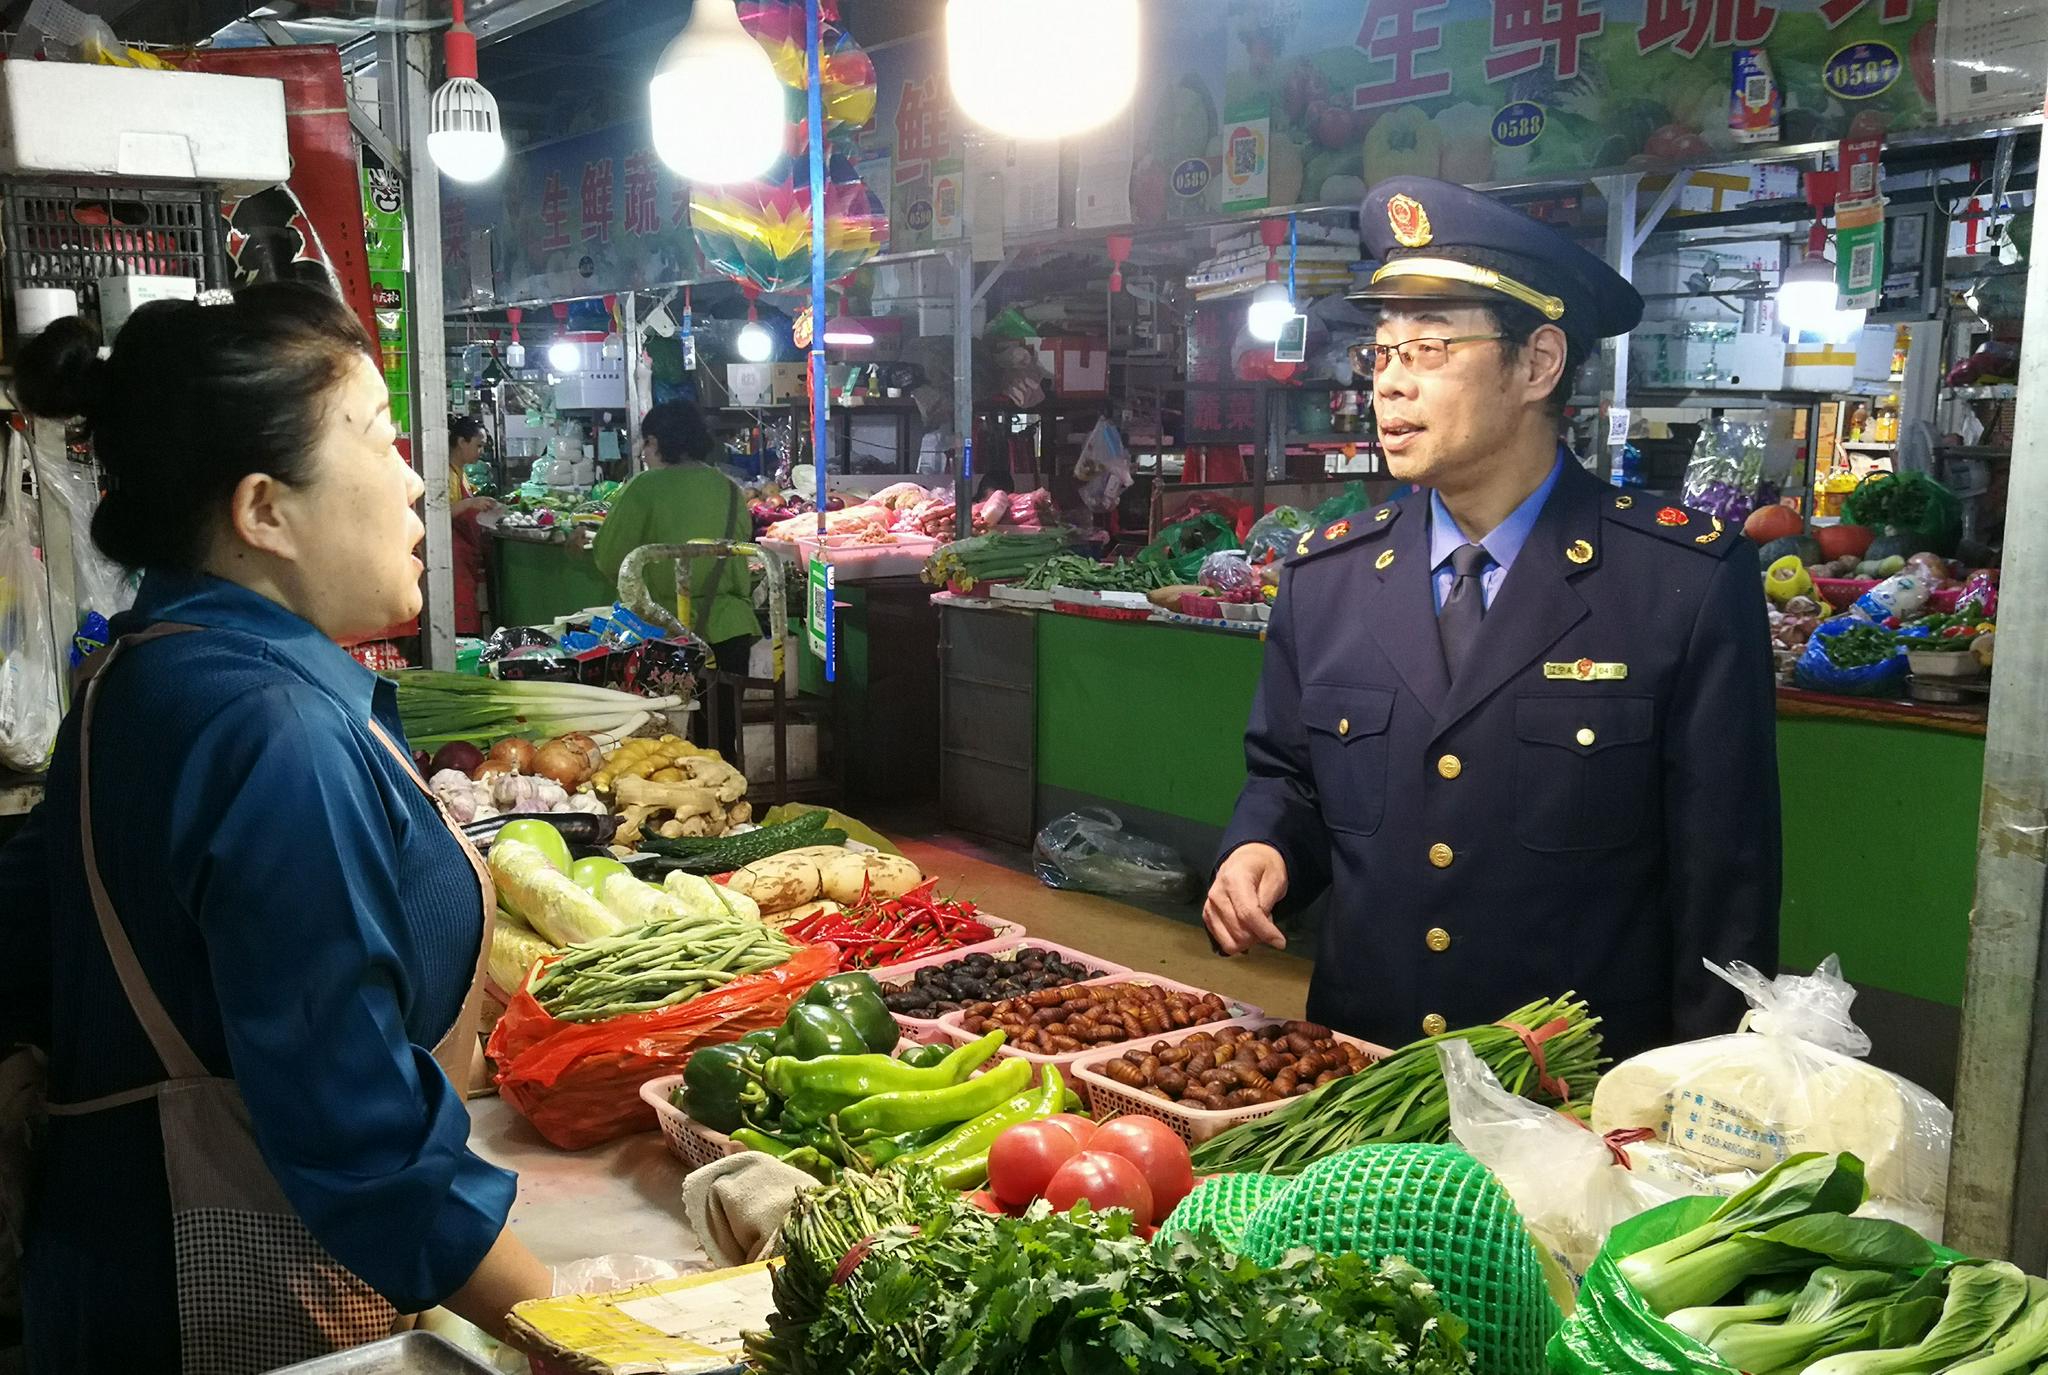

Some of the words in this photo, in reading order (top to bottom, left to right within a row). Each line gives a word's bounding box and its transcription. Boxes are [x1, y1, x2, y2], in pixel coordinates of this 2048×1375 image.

[1833, 58, 1893, 88] 0587
[1497, 115, 1540, 140] 0588
[1176, 170, 1207, 190] 0589
